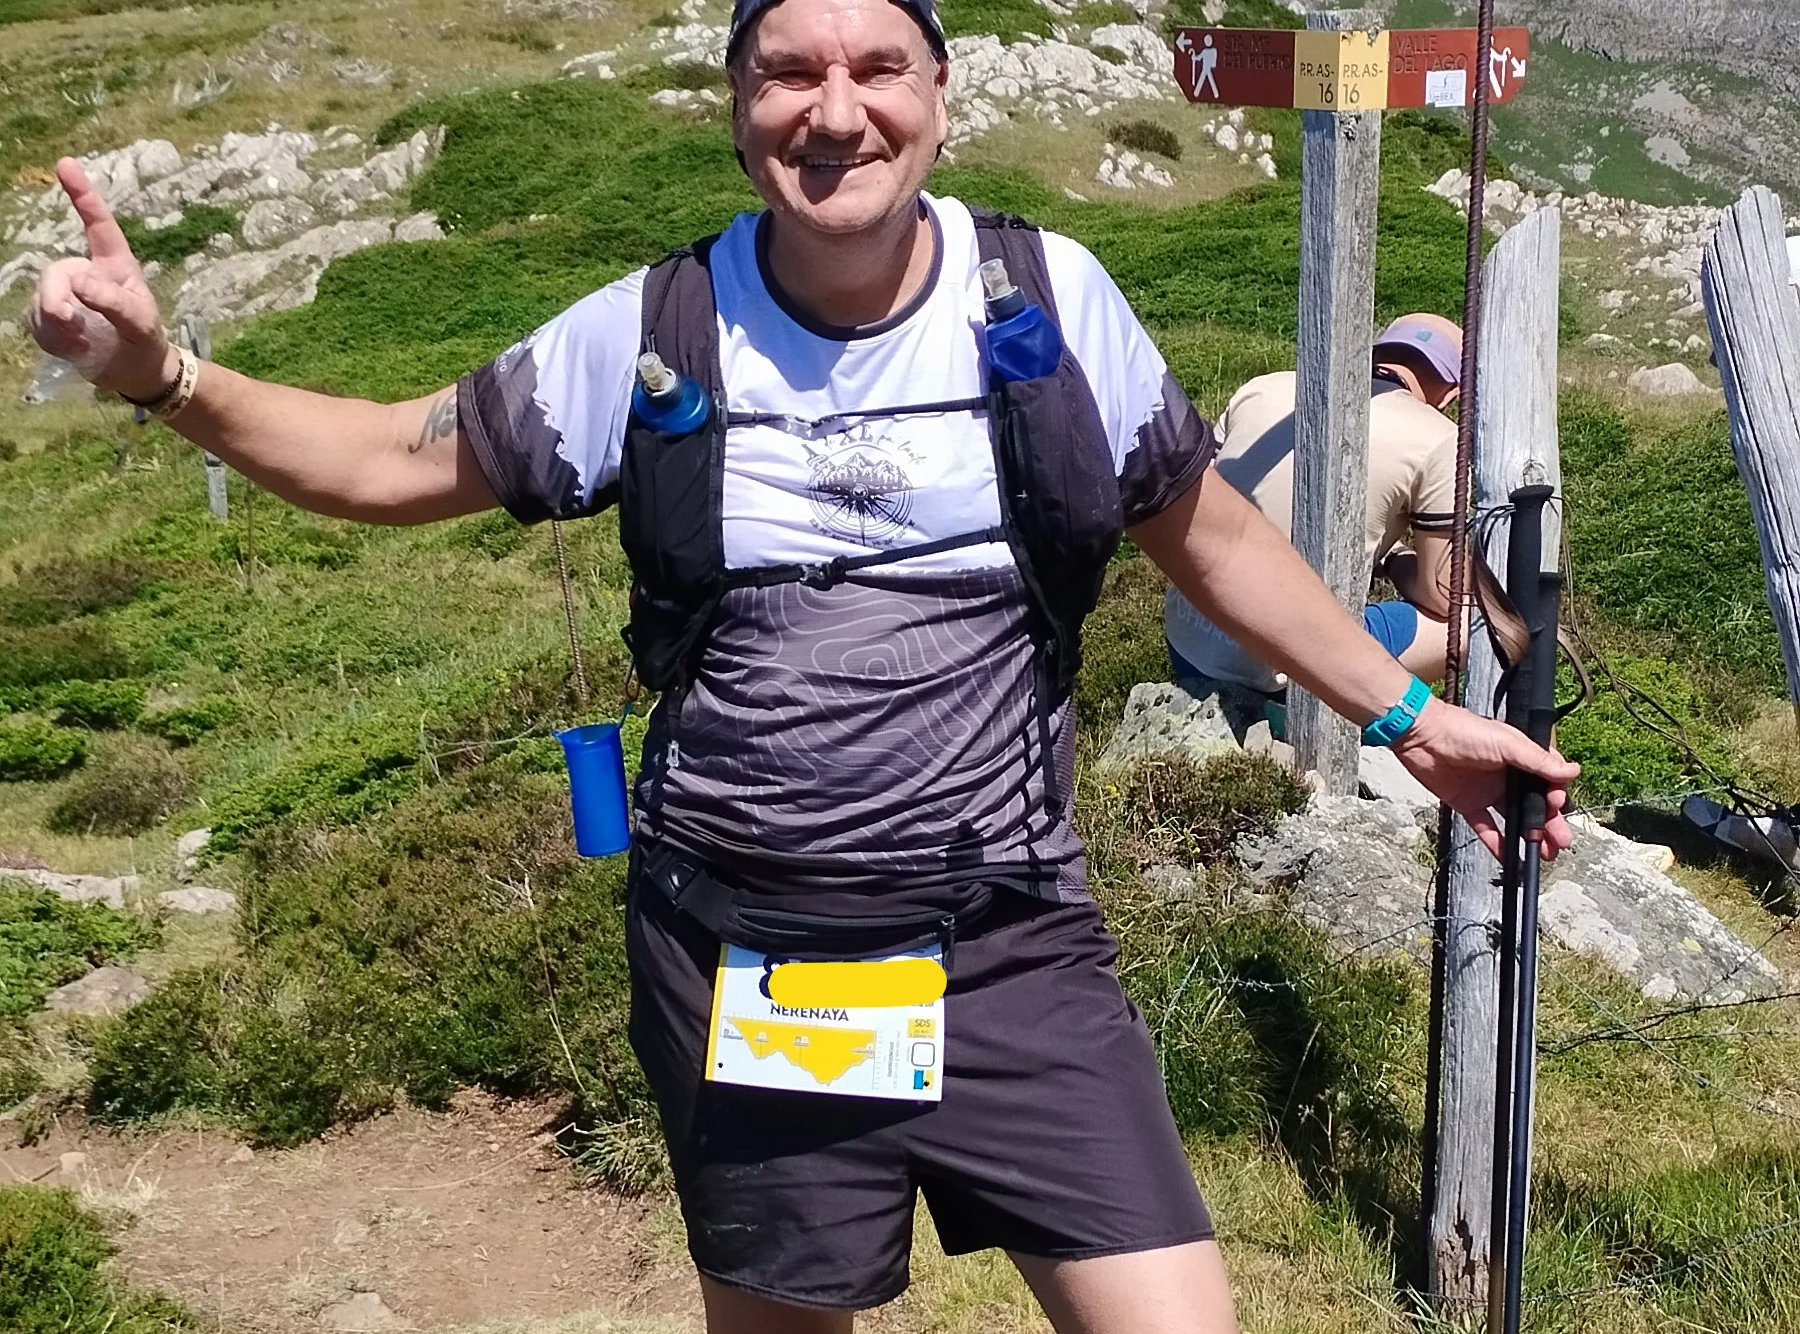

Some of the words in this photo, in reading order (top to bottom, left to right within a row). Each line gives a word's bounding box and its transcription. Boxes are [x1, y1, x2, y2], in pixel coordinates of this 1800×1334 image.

[1395, 34, 1437, 55] VALLE
[1393, 54, 1419, 74] DEL
[1424, 52, 1468, 71] LAGO
[1318, 83, 1334, 104] 16
[1342, 83, 1360, 105] 16
[770, 1002, 849, 1021] NERENAYA
[914, 1018, 931, 1028] SDS
